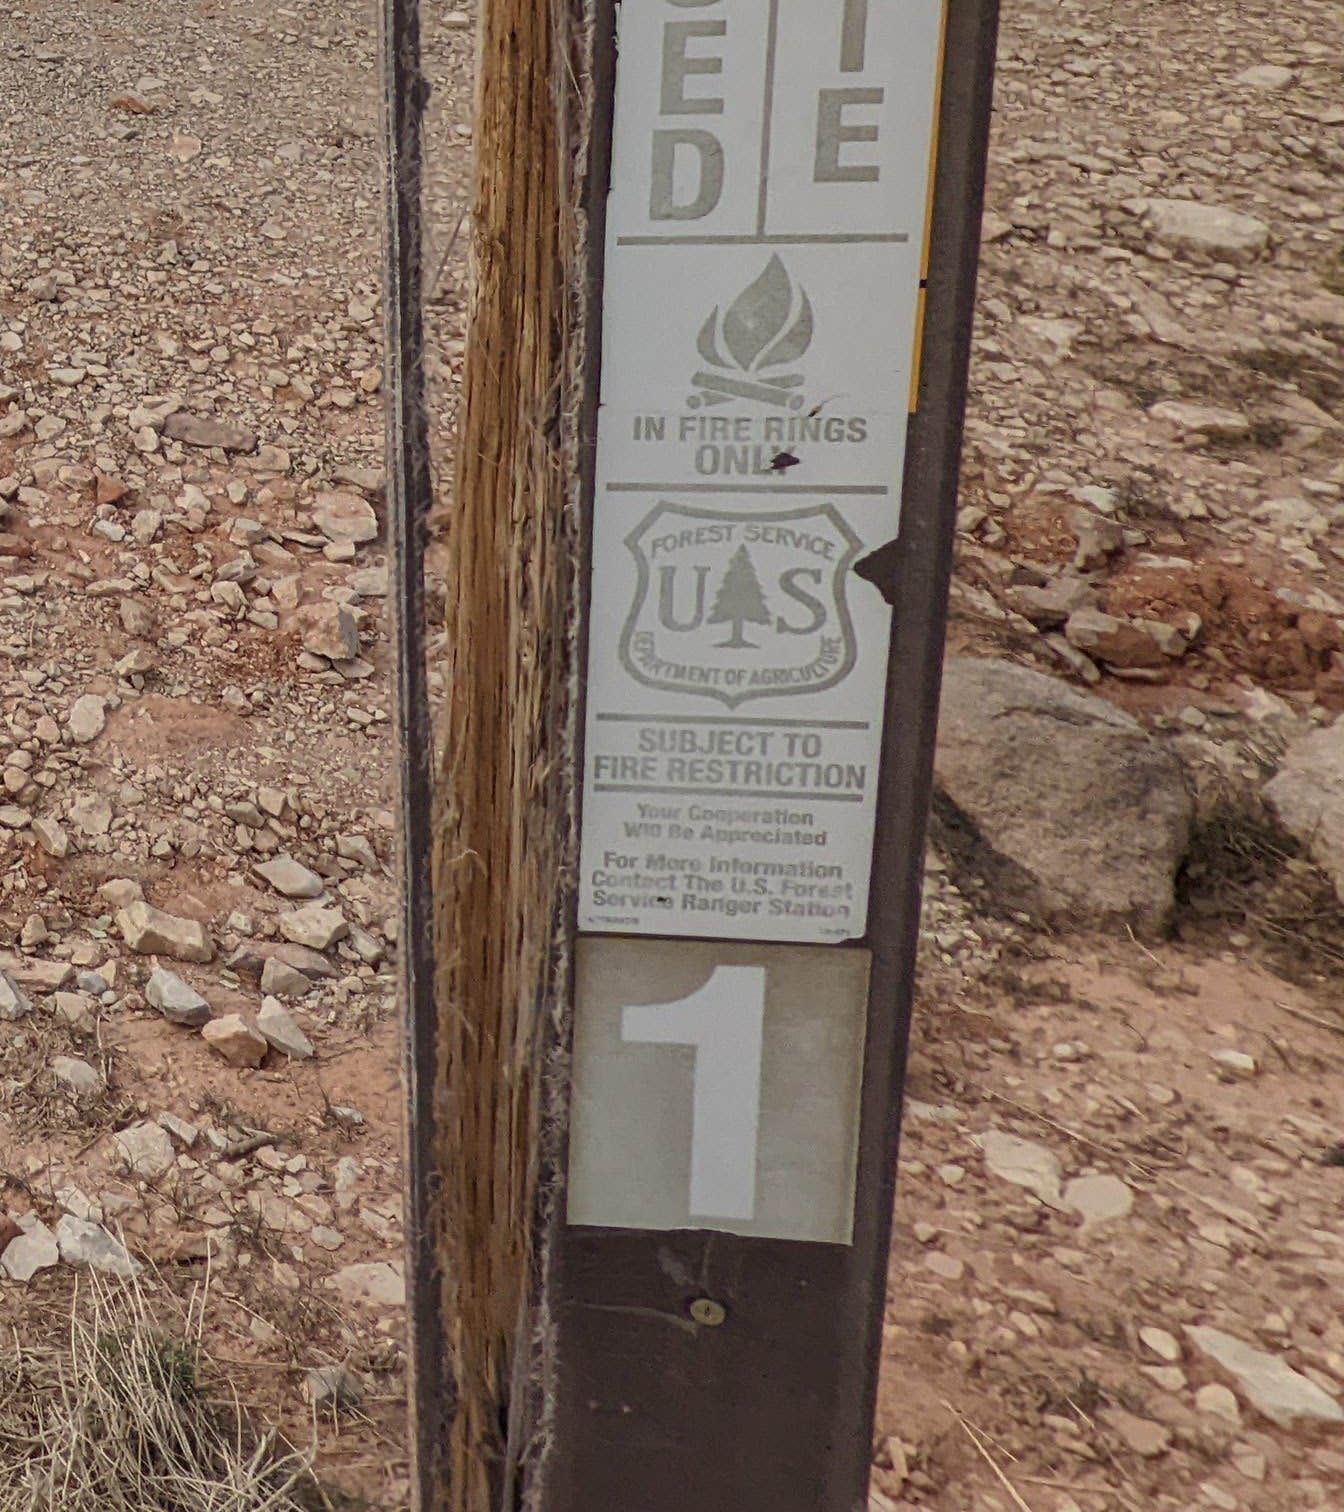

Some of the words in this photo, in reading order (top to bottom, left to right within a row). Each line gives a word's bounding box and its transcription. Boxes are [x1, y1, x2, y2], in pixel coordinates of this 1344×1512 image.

[633, 416, 665, 442] IN
[680, 416, 750, 443] FIRE
[764, 417, 868, 444] RINGS
[650, 524, 737, 558] FOREST
[743, 522, 836, 561] SERVICE
[634, 631, 723, 685] DEPARTMENT
[724, 668, 746, 685] OF
[749, 635, 843, 685] AGRICULTURE
[638, 728, 777, 758] SUBJECT
[783, 734, 823, 759] TO
[594, 755, 658, 781] FIRE
[667, 757, 867, 789] RESTRICTION
[637, 803, 681, 820] Your
[689, 805, 814, 826] Cooperation
[624, 822, 662, 839] Will
[668, 824, 694, 840] Be
[699, 825, 828, 846] Appreciated
[604, 851, 638, 869] For
[645, 854, 701, 873] More
[709, 856, 843, 880] Information
[592, 870, 677, 890] Contact
[684, 874, 723, 892] The
[730, 877, 774, 896] U.S.
[781, 880, 853, 900] Forest
[592, 890, 674, 910] Service
[681, 894, 761, 917] Ranger
[767, 898, 851, 918] Station
[621, 965, 766, 1220] 1
